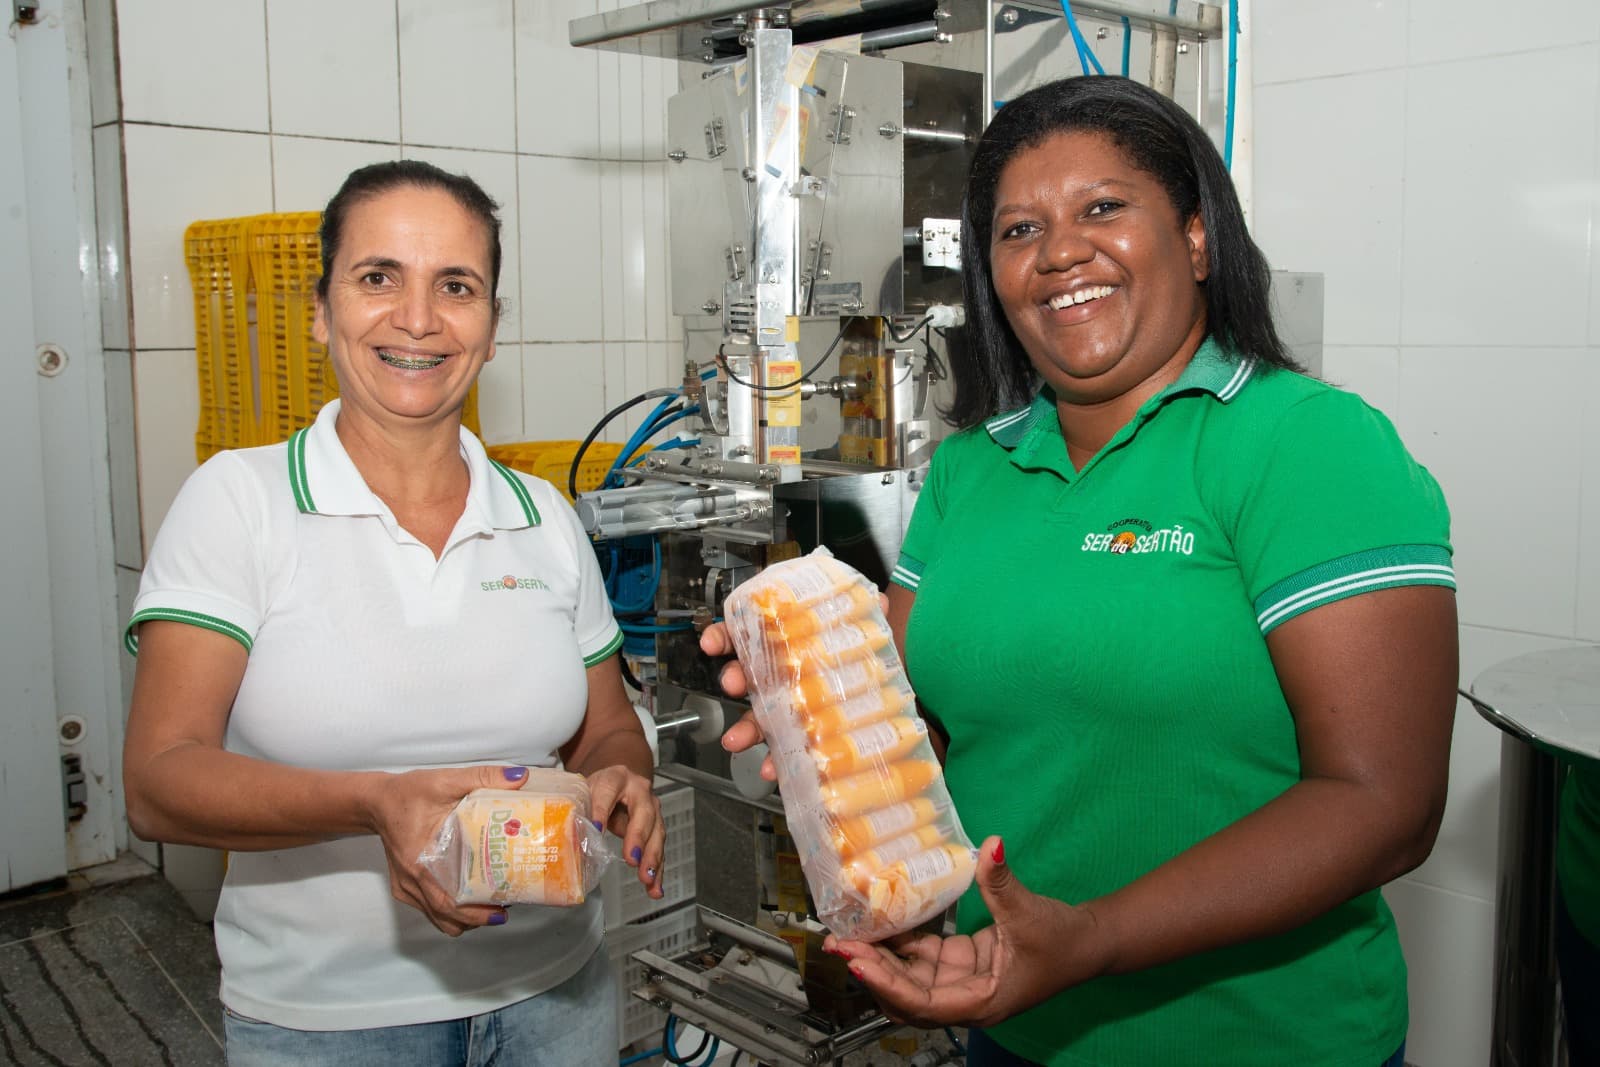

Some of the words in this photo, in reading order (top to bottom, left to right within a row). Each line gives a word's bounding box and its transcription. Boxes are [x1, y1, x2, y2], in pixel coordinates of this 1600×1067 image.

[1081, 533, 1114, 553] SER
[1132, 525, 1195, 555] SERTÃO
[480, 581, 505, 592] SER
